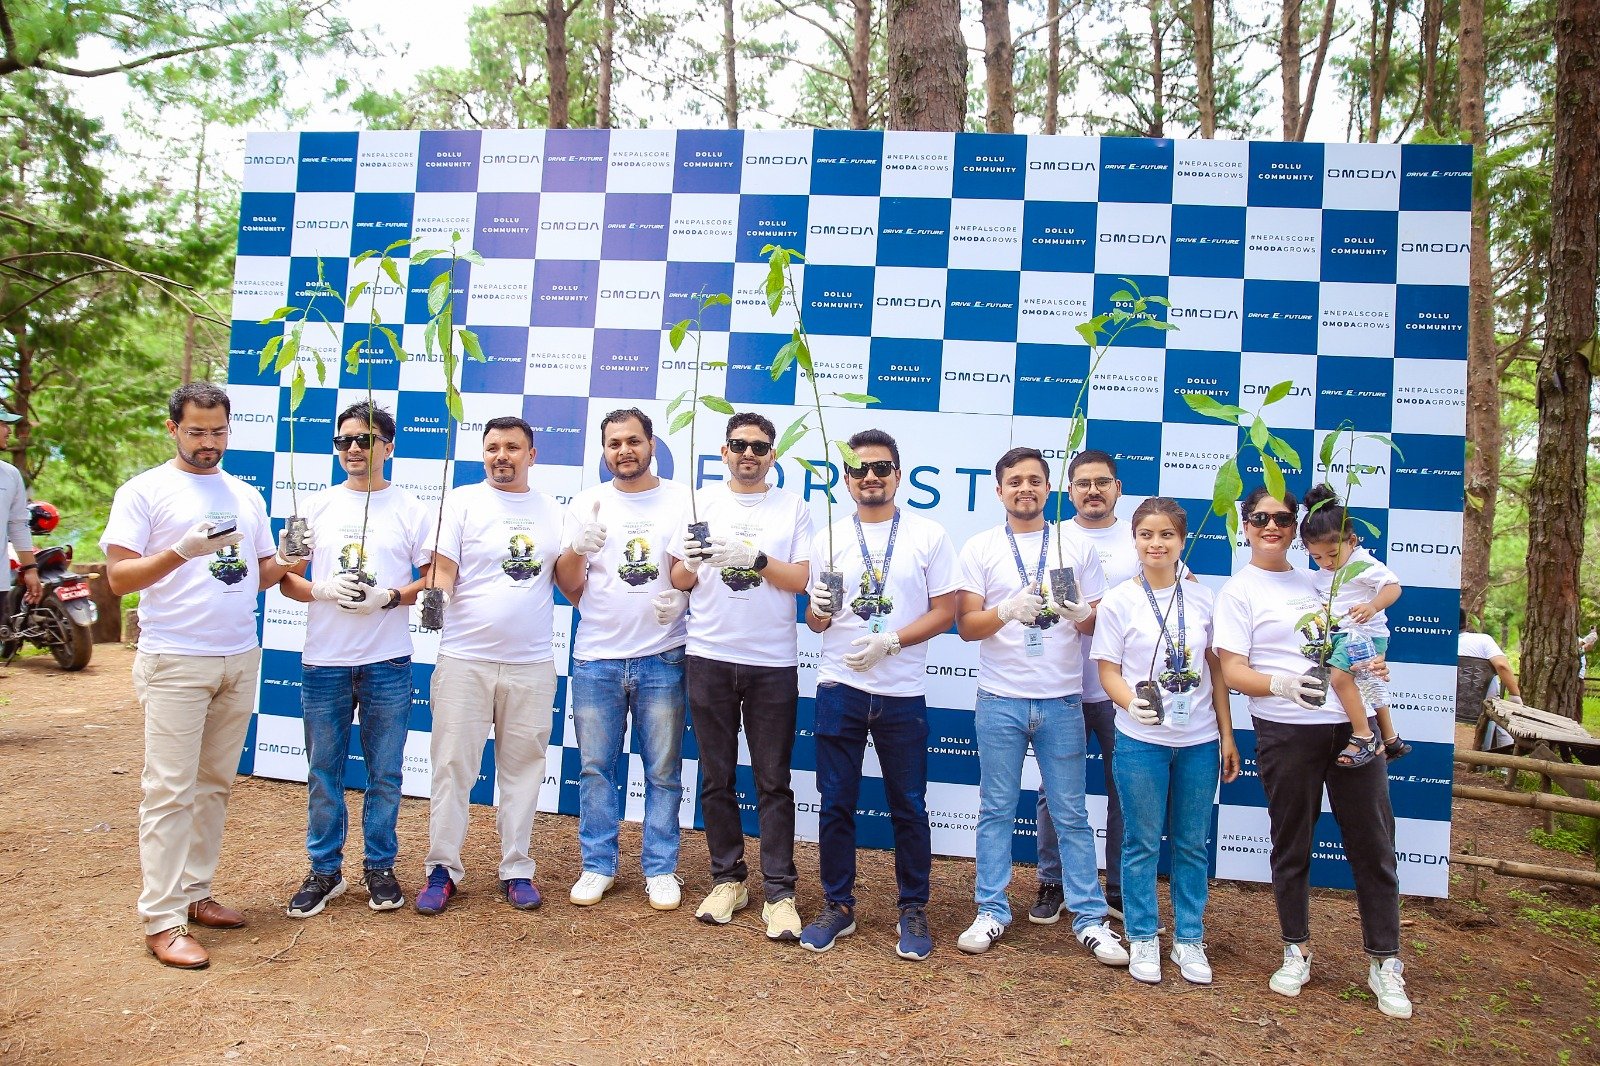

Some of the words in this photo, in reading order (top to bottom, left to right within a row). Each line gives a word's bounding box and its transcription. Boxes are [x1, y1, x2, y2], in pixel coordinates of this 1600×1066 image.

[244, 156, 295, 165] OMODA
[483, 155, 540, 164] OMODA
[745, 156, 808, 165] OMODA
[1178, 160, 1242, 168] #NEPALSCORE
[1029, 161, 1095, 171] OMODA
[1177, 170, 1244, 179] OMODAGROWS
[1258, 173, 1314, 181] COMMUNITY
[1328, 168, 1396, 179] OMODA
[296, 220, 349, 229] OMODA
[540, 221, 600, 231] OMODA
[629, 222, 665, 230] E-FUTURE
[810, 225, 874, 235] OMODA
[953, 235, 1018, 243] OMODAGROWS
[1100, 233, 1166, 244] OMODA
[1199, 237, 1240, 245] E-FUTURE
[1250, 234, 1315, 242] #NEPALSCORE
[1248, 245, 1316, 253] OMODAGROWS
[1331, 247, 1387, 255] COMMUNITY
[1401, 243, 1471, 253] OMODA
[600, 289, 661, 299] OMODA
[811, 301, 864, 309] COMMUNITY
[877, 297, 942, 308] OMODA
[973, 301, 1014, 309] E-FUTURE
[1024, 298, 1087, 306] #NEPALSCORE
[1022, 309, 1088, 317] OMODAGROWS
[1170, 307, 1239, 320] OMODA
[1271, 312, 1313, 320] E-FUTURE
[1323, 310, 1389, 318] #NEPALSCORE
[1322, 321, 1390, 329] OMODAGROWS
[1405, 323, 1463, 331] COMMUNITY
[486, 355, 522, 363] E-FUTURE
[814, 361, 863, 369] EPALSCORE
[800, 372, 864, 380] OODAGROWS
[878, 375, 932, 383] COMMUNITY
[944, 372, 1011, 383] OMODA
[1044, 376, 1085, 384] E-FUTURE
[1093, 374, 1158, 382] #NEPALSCORE
[1187, 377, 1217, 385] DOLLU
[1092, 384, 1159, 393] OMODAGROWS
[1173, 388, 1230, 397] COMMUNITY
[1243, 384, 1312, 397] OMDA
[1345, 389, 1387, 397] E-FUTURE
[1398, 387, 1465, 395] #NEPALSCORE
[1396, 398, 1466, 406] OMODAGROWS
[229, 413, 274, 423] MODA
[1113, 453, 1155, 461] E-FUTURE
[1165, 451, 1231, 460] #NEPALSCORE
[1164, 462, 1220, 471] OMODAGRO
[696, 454, 992, 512] FRST
[1391, 542, 1462, 555] OMODA
[268, 608, 308, 617] #NEPALSCO
[266, 618, 308, 626] OMODAGRO
[1394, 626, 1452, 635] COMMUNITY
[926, 665, 979, 678] OMOD
[1389, 691, 1454, 701] NEPALSCORE
[1389, 703, 1455, 713] MODAGROWS
[1408, 775, 1451, 785] E-FUTURE
[1223, 834, 1270, 843] #NEPALSC
[1319, 841, 1344, 849] DOLL
[1221, 845, 1272, 855] OMODAGR
[1312, 852, 1348, 861] OMMUN
